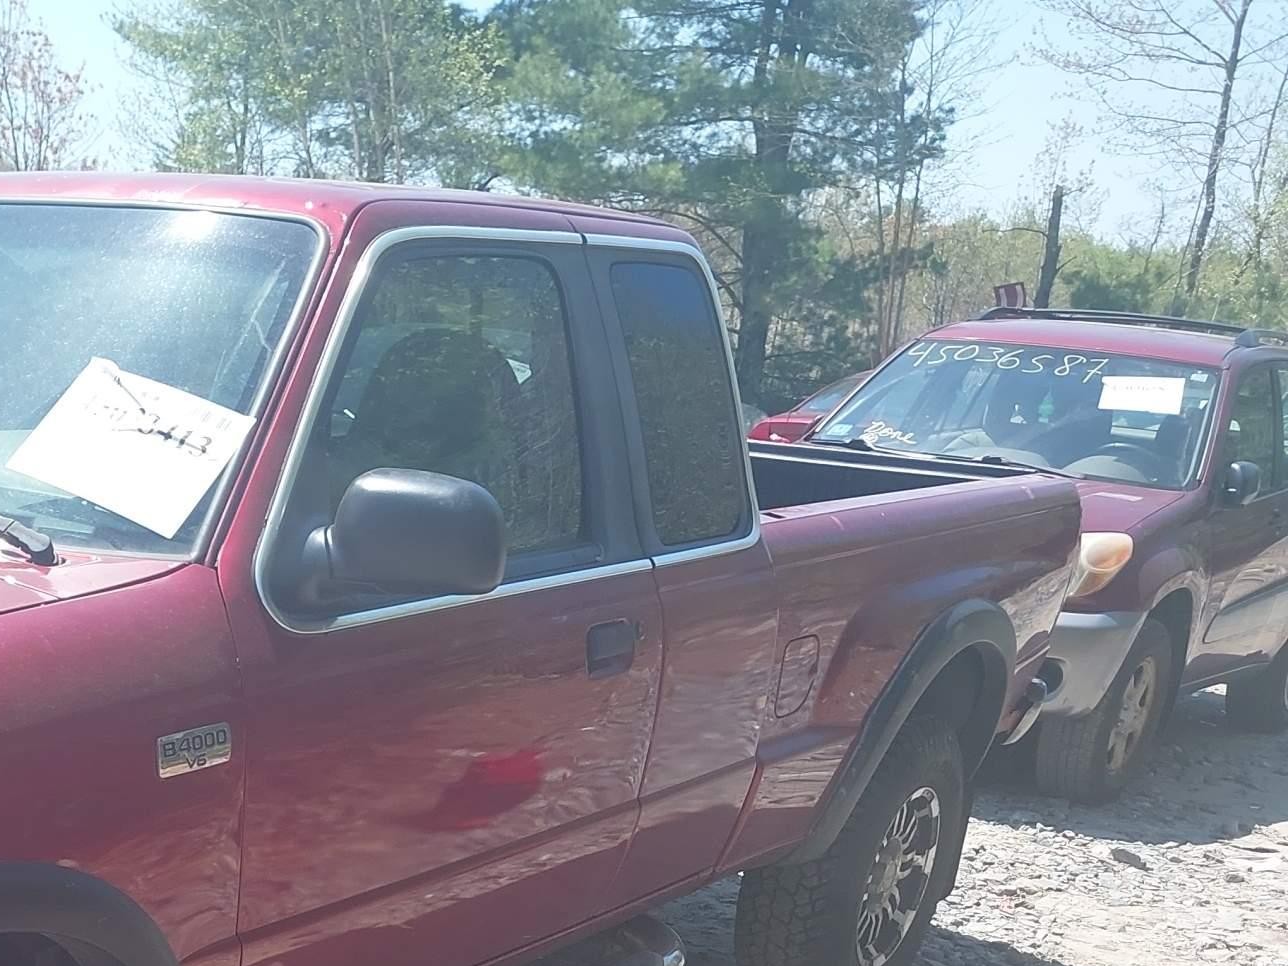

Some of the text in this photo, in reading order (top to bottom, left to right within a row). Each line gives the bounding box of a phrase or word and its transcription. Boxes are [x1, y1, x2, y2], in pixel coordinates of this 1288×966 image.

[908, 342, 1110, 384] 45036587
[162, 729, 228, 758] B4000
[185, 752, 209, 769] V6
